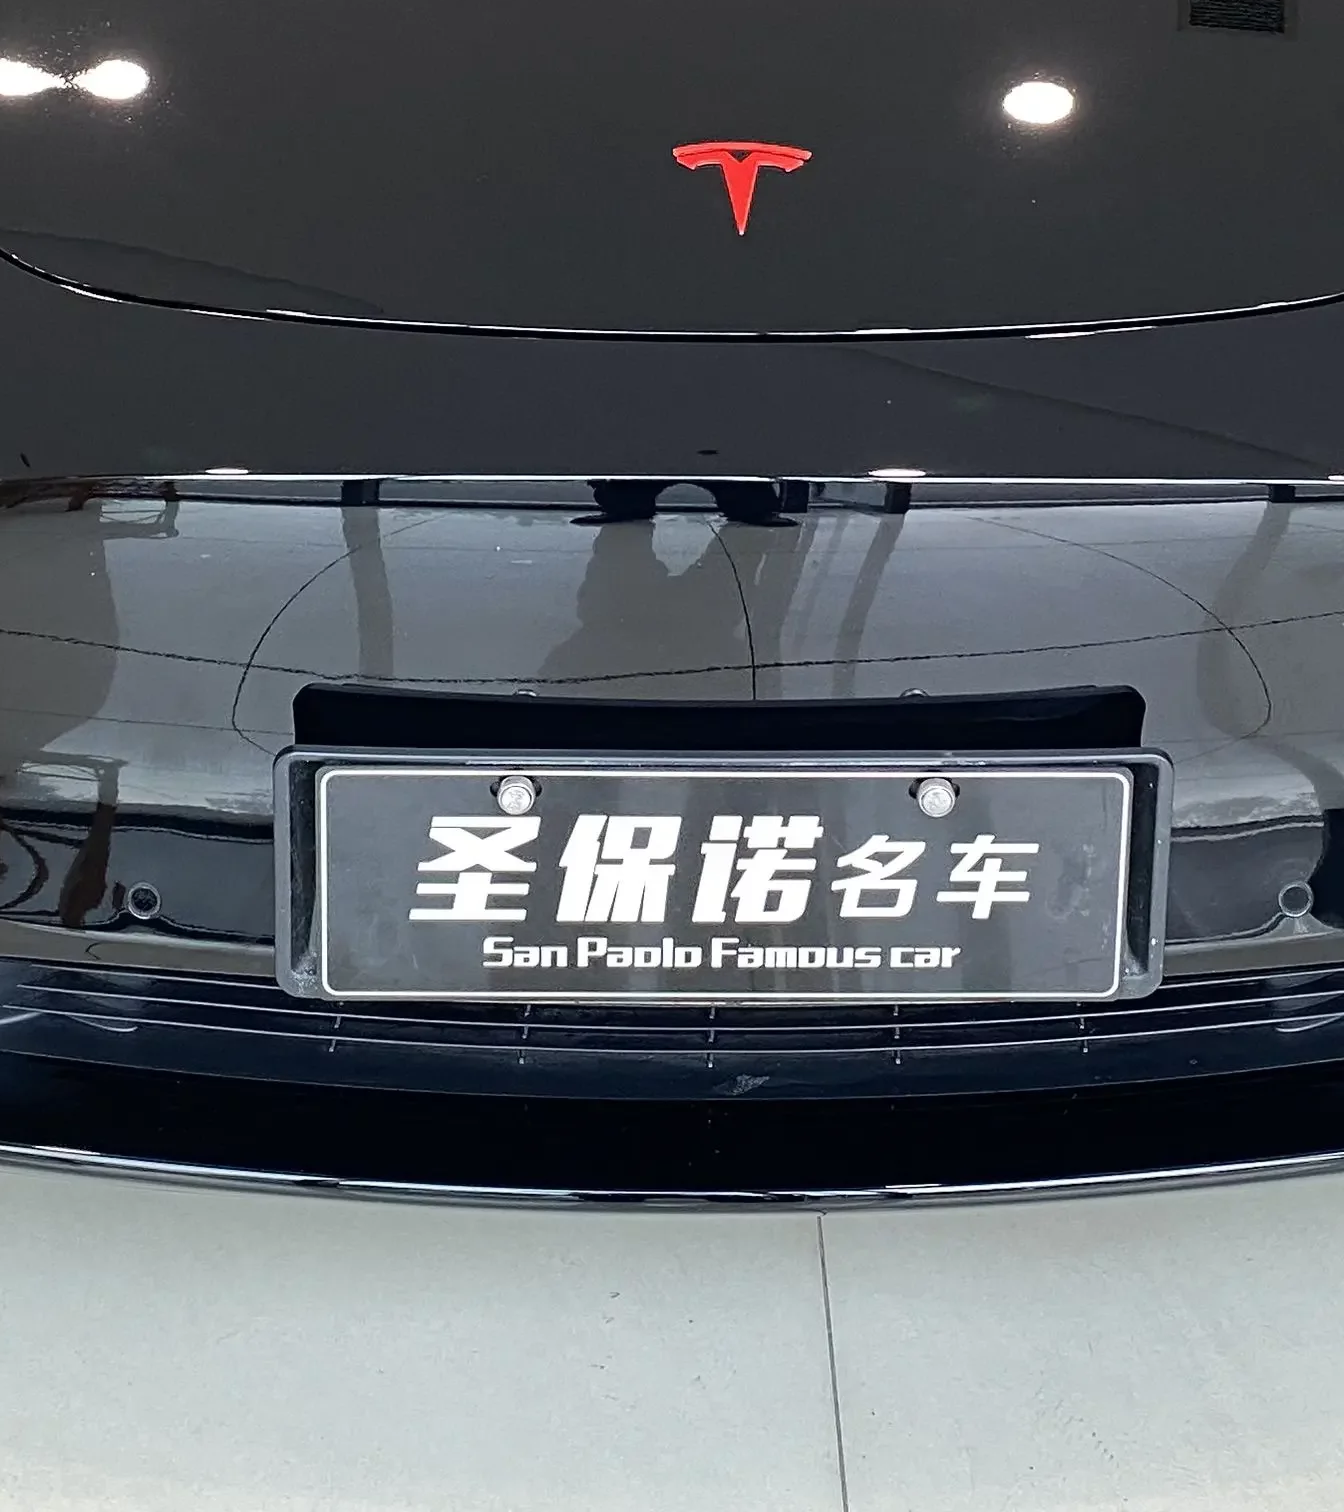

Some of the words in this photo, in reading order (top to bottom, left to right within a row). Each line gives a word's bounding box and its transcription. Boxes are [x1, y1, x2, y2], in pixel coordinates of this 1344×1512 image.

[408, 815, 1040, 923] 圣保诺名车
[482, 936, 568, 969] San
[577, 937, 703, 969] Paolo
[710, 937, 882, 969] Famous
[889, 946, 961, 969] car
